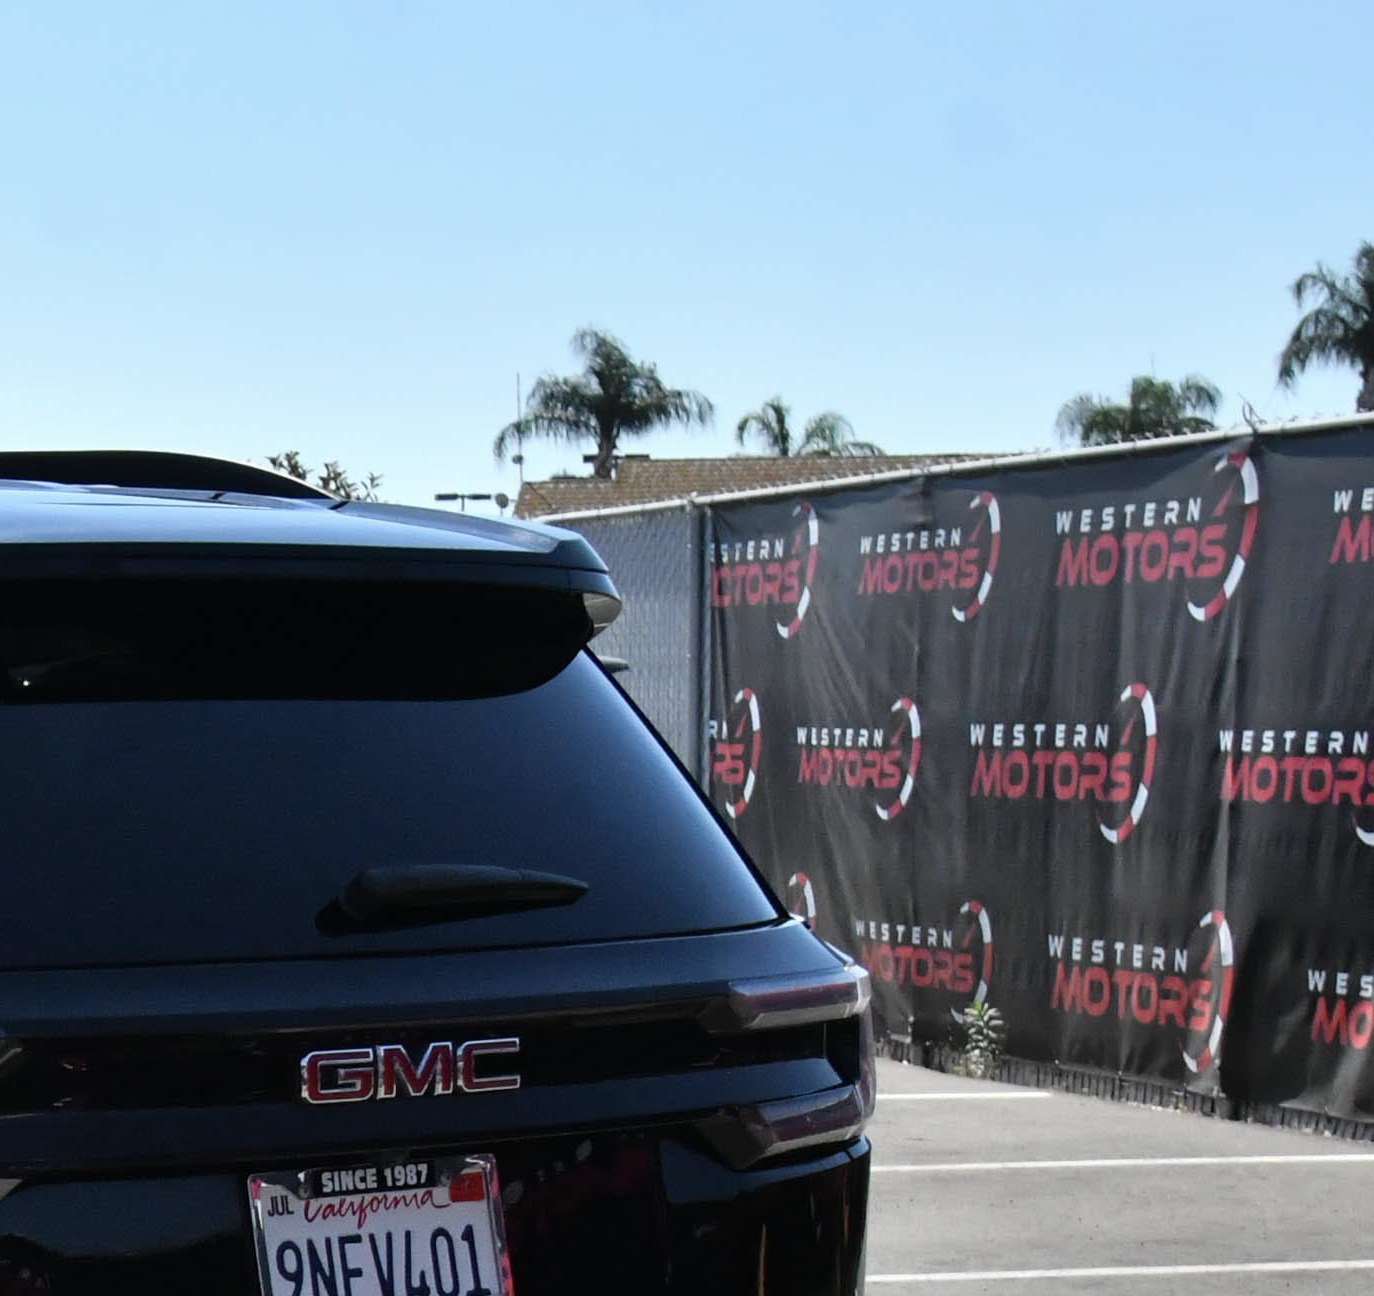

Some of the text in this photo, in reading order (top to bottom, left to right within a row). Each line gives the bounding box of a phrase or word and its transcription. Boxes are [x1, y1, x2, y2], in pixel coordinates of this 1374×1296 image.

[1056, 497, 1201, 535] WESTERN
[860, 528, 961, 554] WESTERN
[1055, 524, 1228, 587] MOTORS
[1329, 513, 1374, 564] M
[857, 548, 980, 595] MOTORS
[796, 727, 884, 748] WESTERN
[970, 723, 1110, 747] WESTERN
[1219, 730, 1368, 754] WESTERN
[798, 746, 902, 789] MOTORS
[970, 749, 1132, 803] MOTORS
[855, 919, 952, 949] WESTERN
[1048, 934, 1189, 974] WESTERN
[861, 943, 974, 993] MOTORS
[1051, 962, 1212, 1032] MOTORS
[300, 1038, 520, 1104] GMC
[321, 1163, 428, 1194] SINCE 1987
[267, 1195, 294, 1217] JUL
[304, 1189, 451, 1229] California
